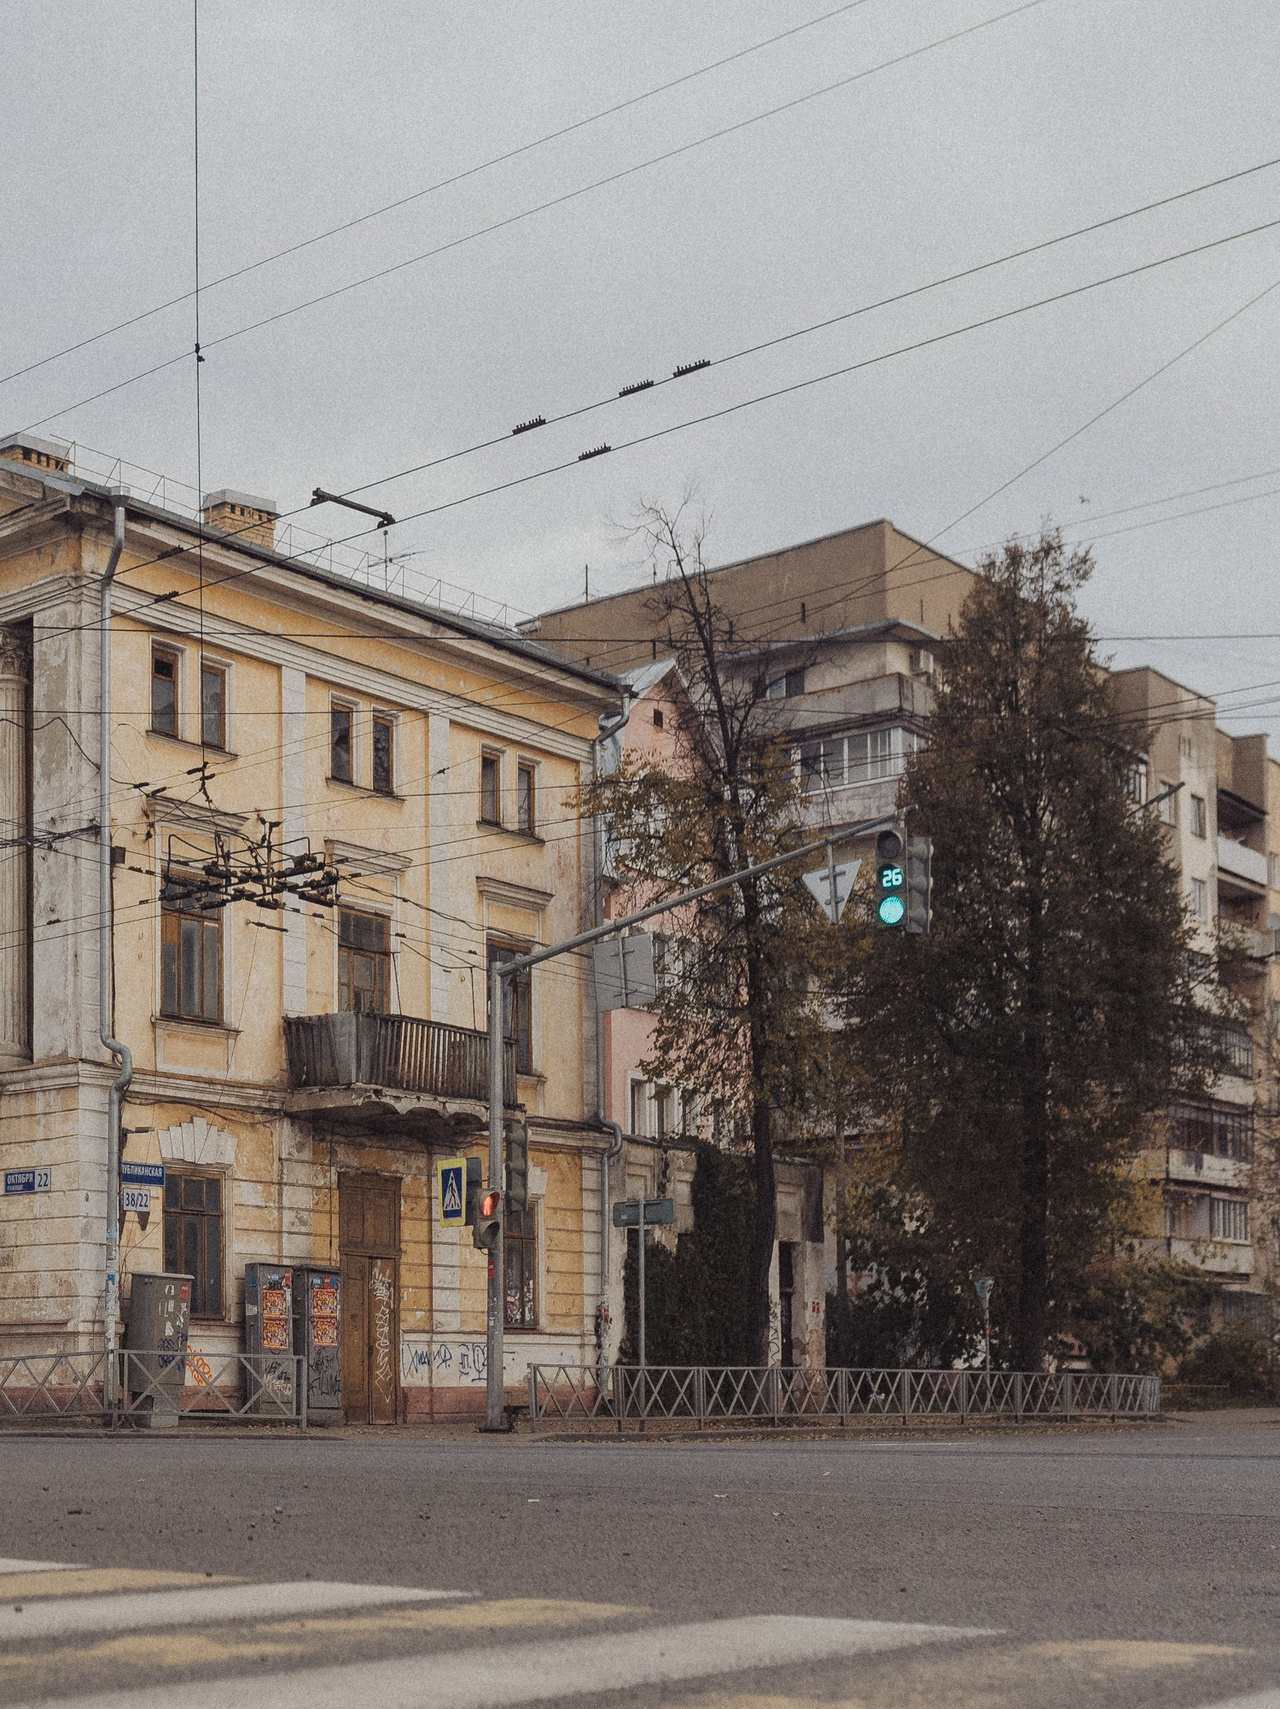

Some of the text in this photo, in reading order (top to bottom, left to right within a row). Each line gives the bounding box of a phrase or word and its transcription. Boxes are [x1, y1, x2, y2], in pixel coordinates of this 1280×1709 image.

[882, 868, 903, 888] 26
[122, 1164, 163, 1178] УБЛИКАНСКАЯ
[7, 1173, 34, 1185] ОКТЯБРЯ
[37, 1172, 49, 1188] 22
[125, 1192, 149, 1209] 38/22
